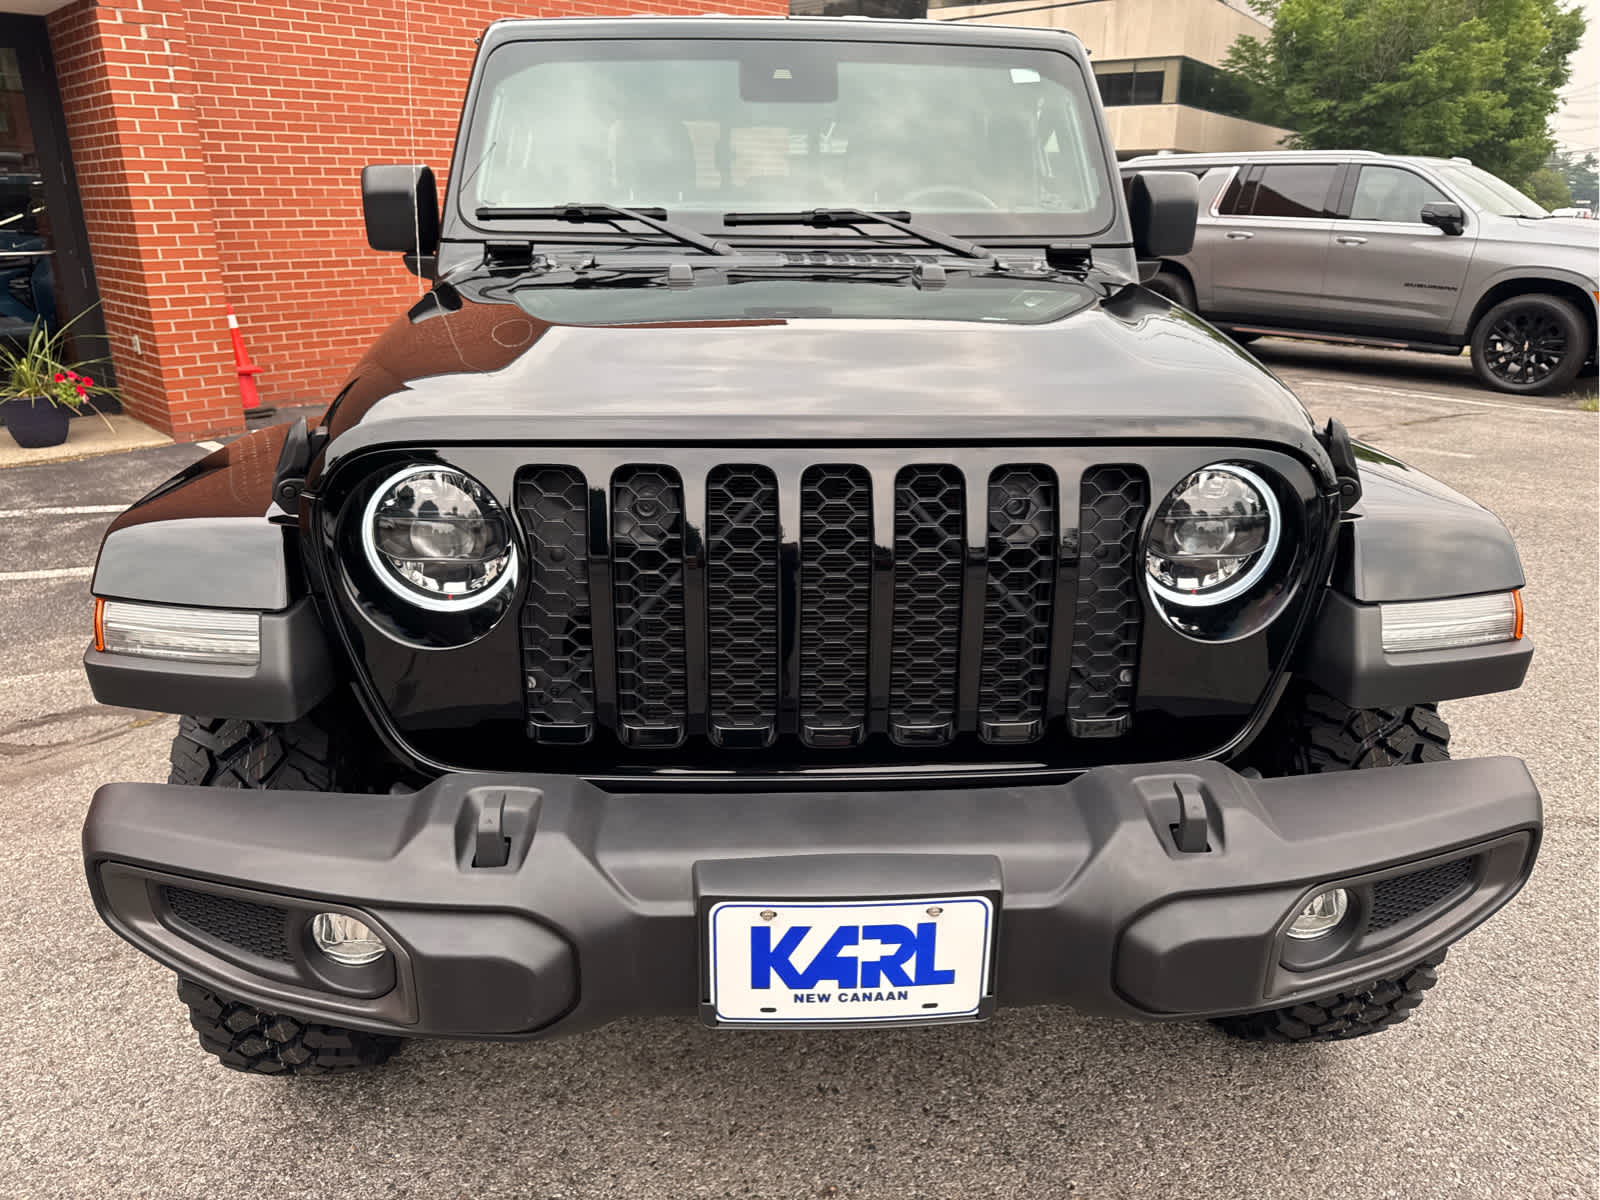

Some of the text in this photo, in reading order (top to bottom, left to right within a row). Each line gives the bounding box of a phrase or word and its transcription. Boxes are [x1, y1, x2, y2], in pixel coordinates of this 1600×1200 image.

[751, 922, 955, 989] KARL
[793, 990, 908, 1003] NEW CANAAN
